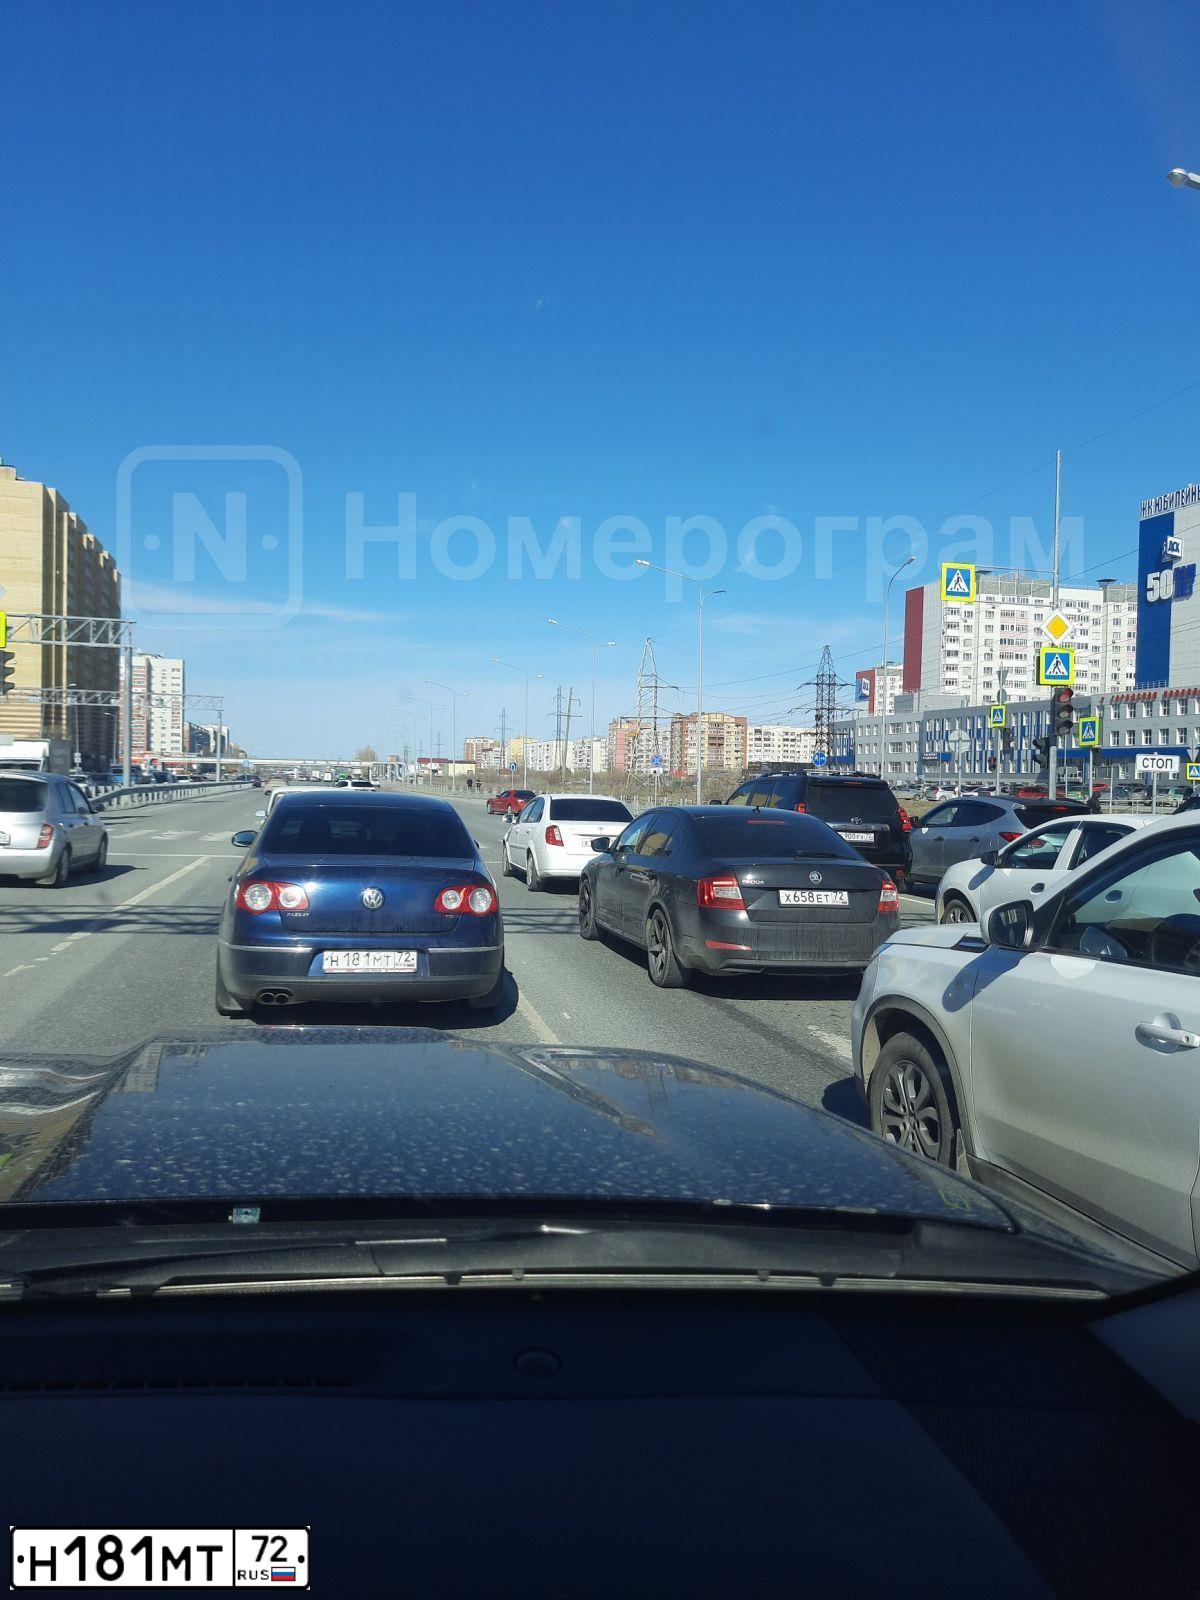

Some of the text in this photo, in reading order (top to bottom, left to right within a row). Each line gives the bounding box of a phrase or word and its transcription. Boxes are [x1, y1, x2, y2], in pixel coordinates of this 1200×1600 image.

[1146, 569, 1174, 602] 50
[1142, 757, 1173, 769] СТОП
[785, 892, 829, 903] Х658ЕТ
[833, 892, 845, 901] 72
[330, 953, 391, 967] Н181МТ
[398, 951, 411, 963] 72
